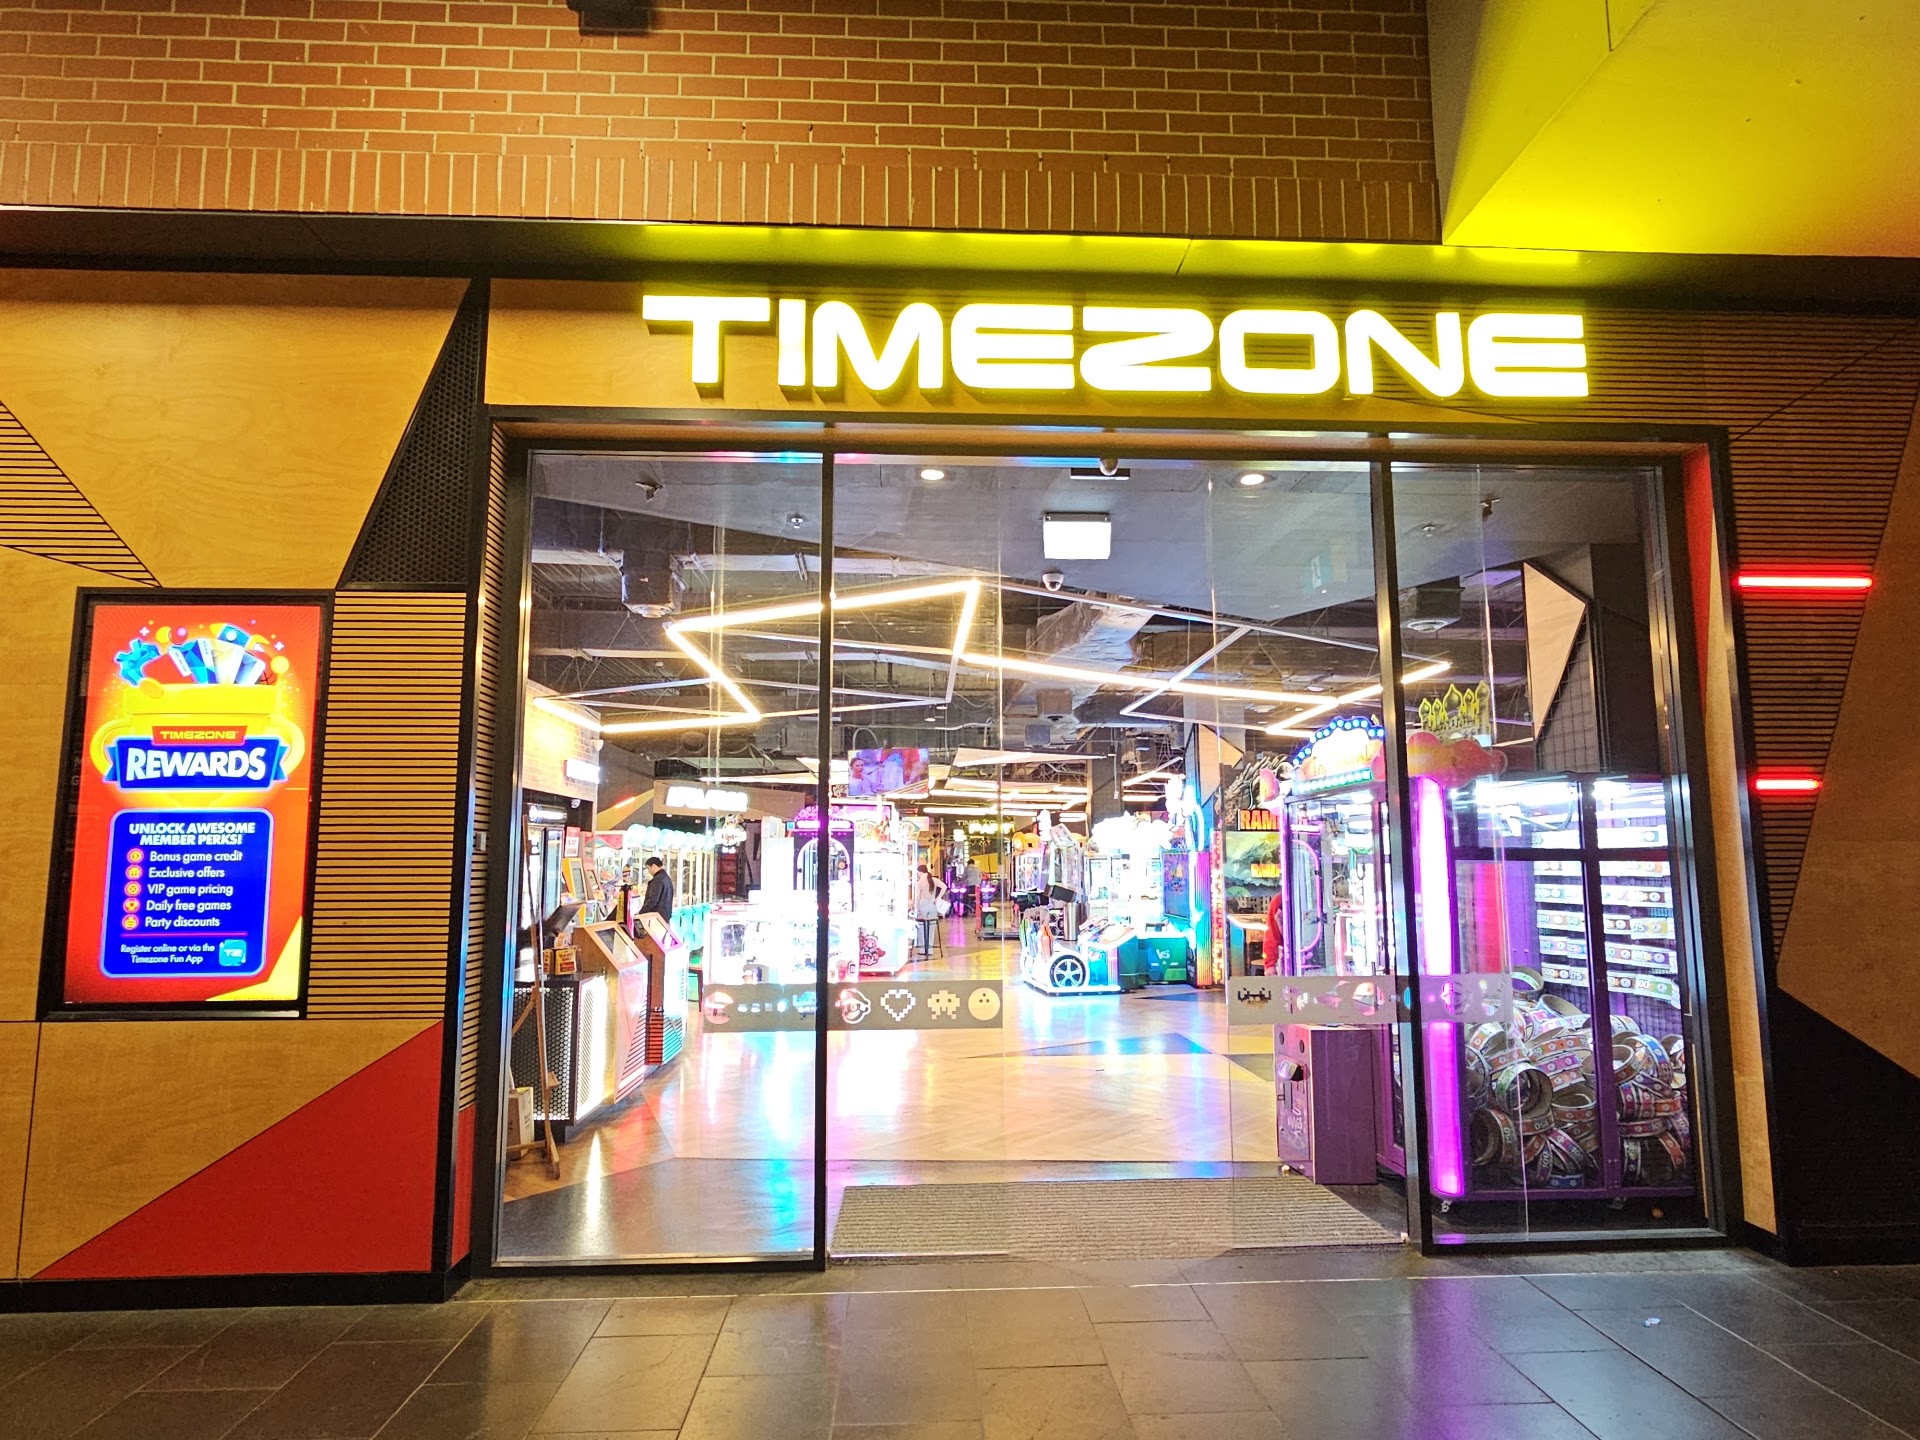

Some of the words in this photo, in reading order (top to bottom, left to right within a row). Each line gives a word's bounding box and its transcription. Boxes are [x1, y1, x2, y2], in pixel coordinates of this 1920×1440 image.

[642, 295, 1589, 398] TIMEZONE
[160, 731, 235, 739] TIMEZONE
[126, 747, 266, 781] REWARDS
[1240, 809, 1280, 830] RAM
[129, 823, 185, 834] UNLOCK
[187, 823, 256, 834] AWESOME
[140, 834, 195, 845] MEMBER
[198, 834, 243, 845] PERKS!
[150, 851, 181, 862] Bonus
[183, 853, 212, 864] game
[214, 850, 243, 862] credit
[148, 867, 195, 878] Exclusive
[196, 866, 225, 878] offers
[148, 884, 165, 894] VIP
[166, 886, 195, 897] game
[198, 884, 233, 897] pricing
[146, 900, 173, 913] Daily
[175, 899, 195, 911] free
[197, 901, 232, 913] games
[145, 917, 172, 929] Party
[173, 915, 220, 927] discounts
[121, 944, 151, 954] Register
[152, 943, 177, 953] online
[188, 943, 201, 952] via
[202, 943, 215, 952] the
[131, 955, 169, 964] Timezone
[170, 955, 184, 963] Fun
[185, 955, 203, 964] App
